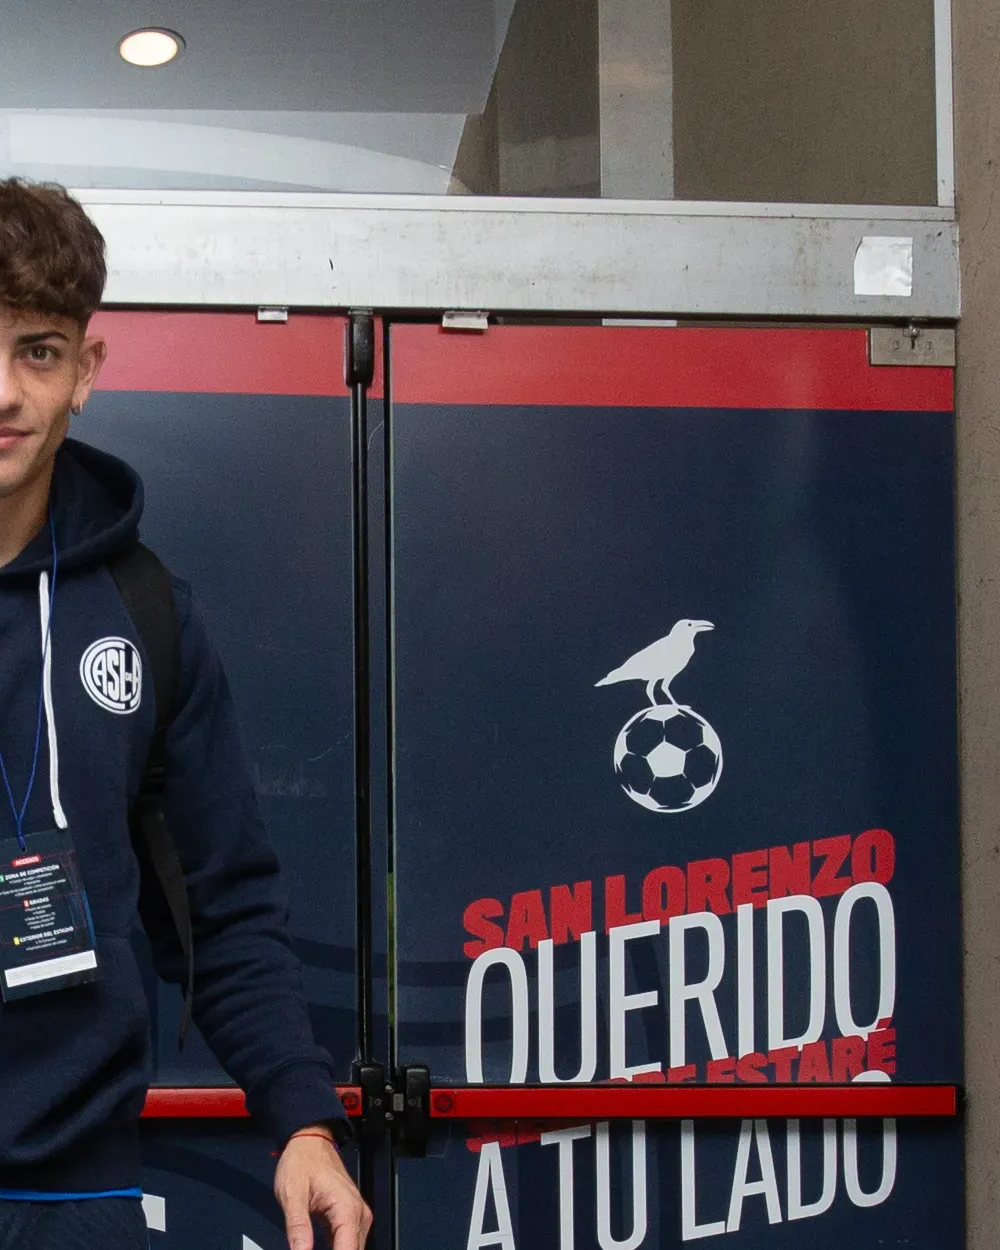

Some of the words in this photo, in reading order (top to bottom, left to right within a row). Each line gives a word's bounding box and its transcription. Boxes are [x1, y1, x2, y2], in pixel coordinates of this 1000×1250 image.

[463, 879, 593, 959] SAN
[605, 829, 896, 935] LORENZO
[465, 882, 896, 1083] QUERIDO
[681, 1070, 897, 1242] LADO
